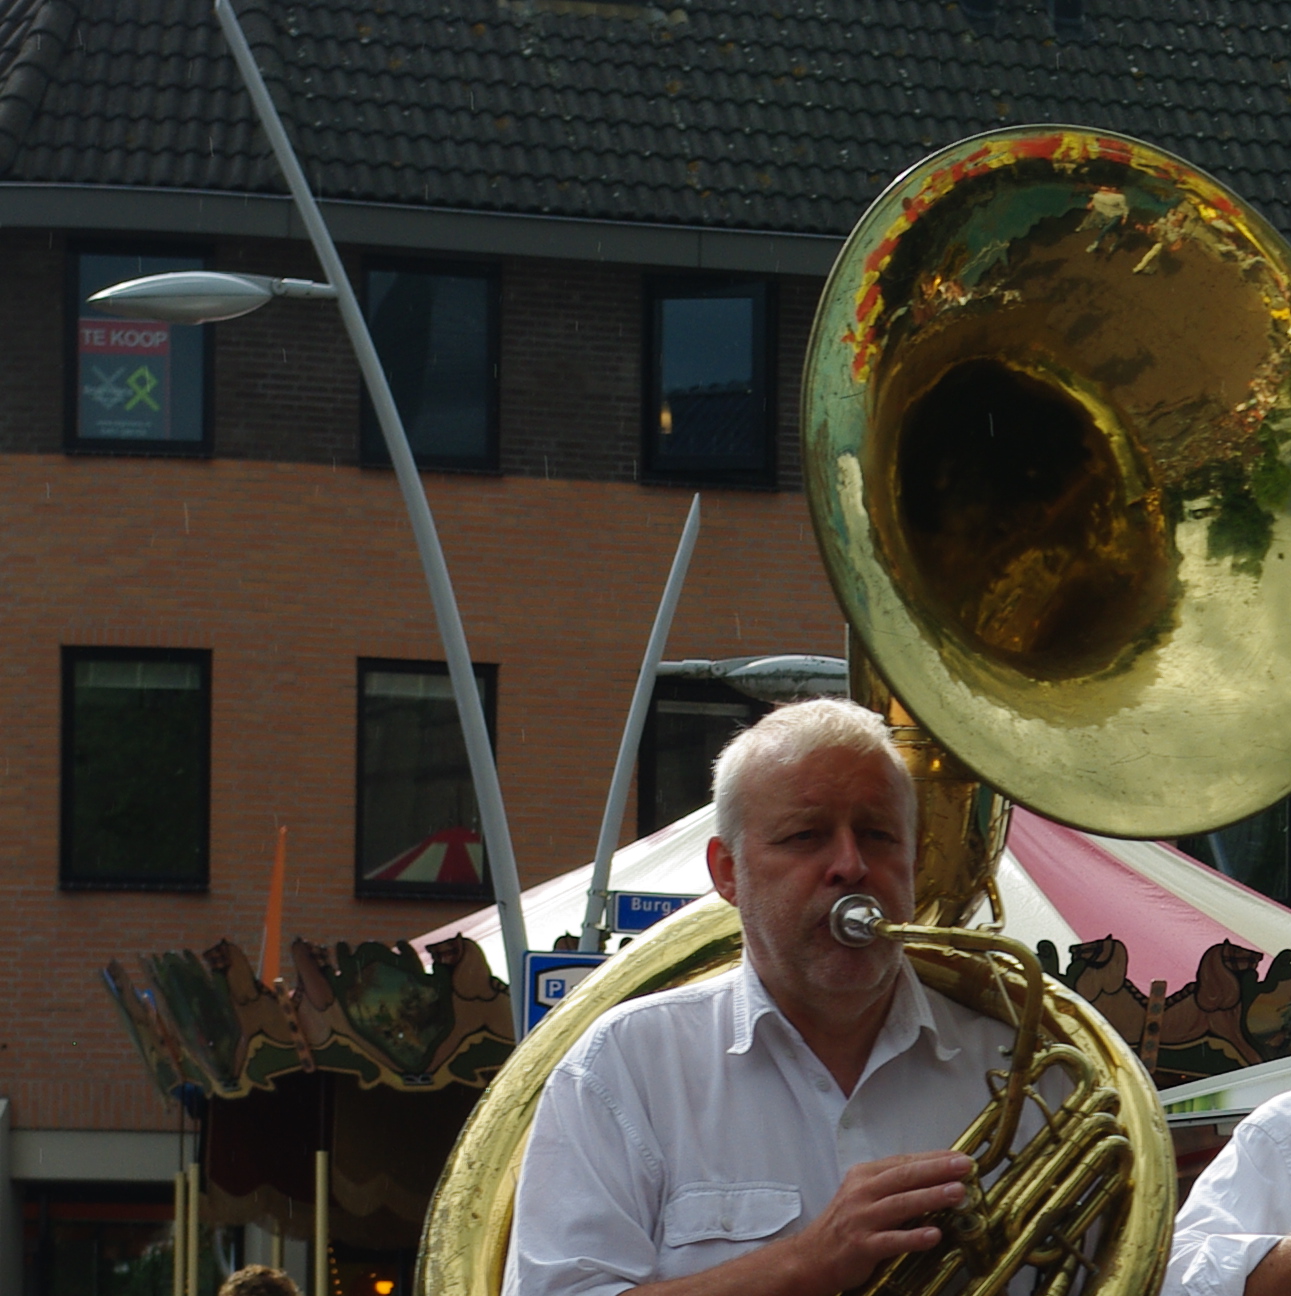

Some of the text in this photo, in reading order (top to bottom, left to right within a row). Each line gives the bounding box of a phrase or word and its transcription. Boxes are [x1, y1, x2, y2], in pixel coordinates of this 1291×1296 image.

[82, 328, 168, 348] TE KOOP
[630, 897, 676, 914] Burg.
[549, 982, 562, 998] P
